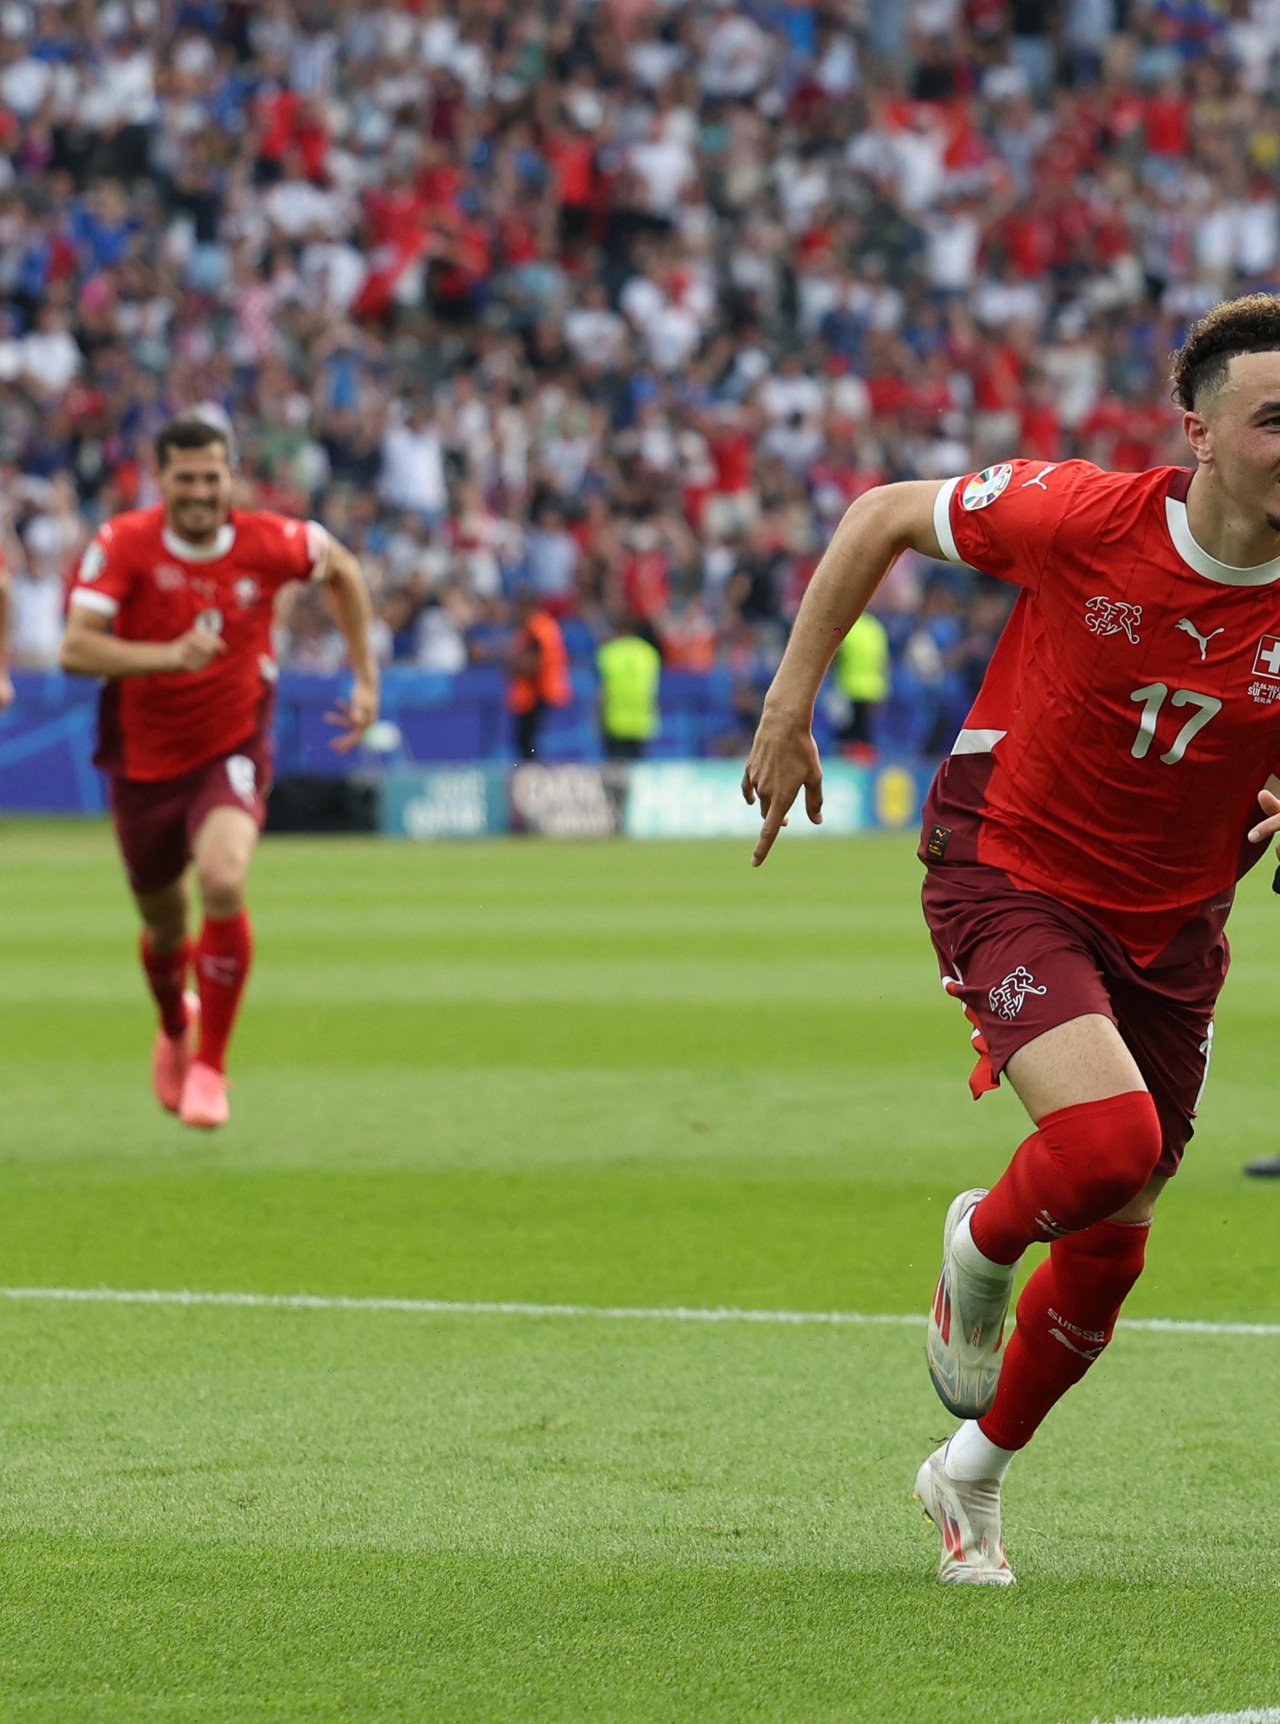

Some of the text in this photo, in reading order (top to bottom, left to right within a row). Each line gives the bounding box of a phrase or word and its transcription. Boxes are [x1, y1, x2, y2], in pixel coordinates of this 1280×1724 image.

[1247, 686, 1261, 697] SUI
[1130, 682, 1223, 765] 17
[1047, 1307, 1104, 1342] SUISSE
